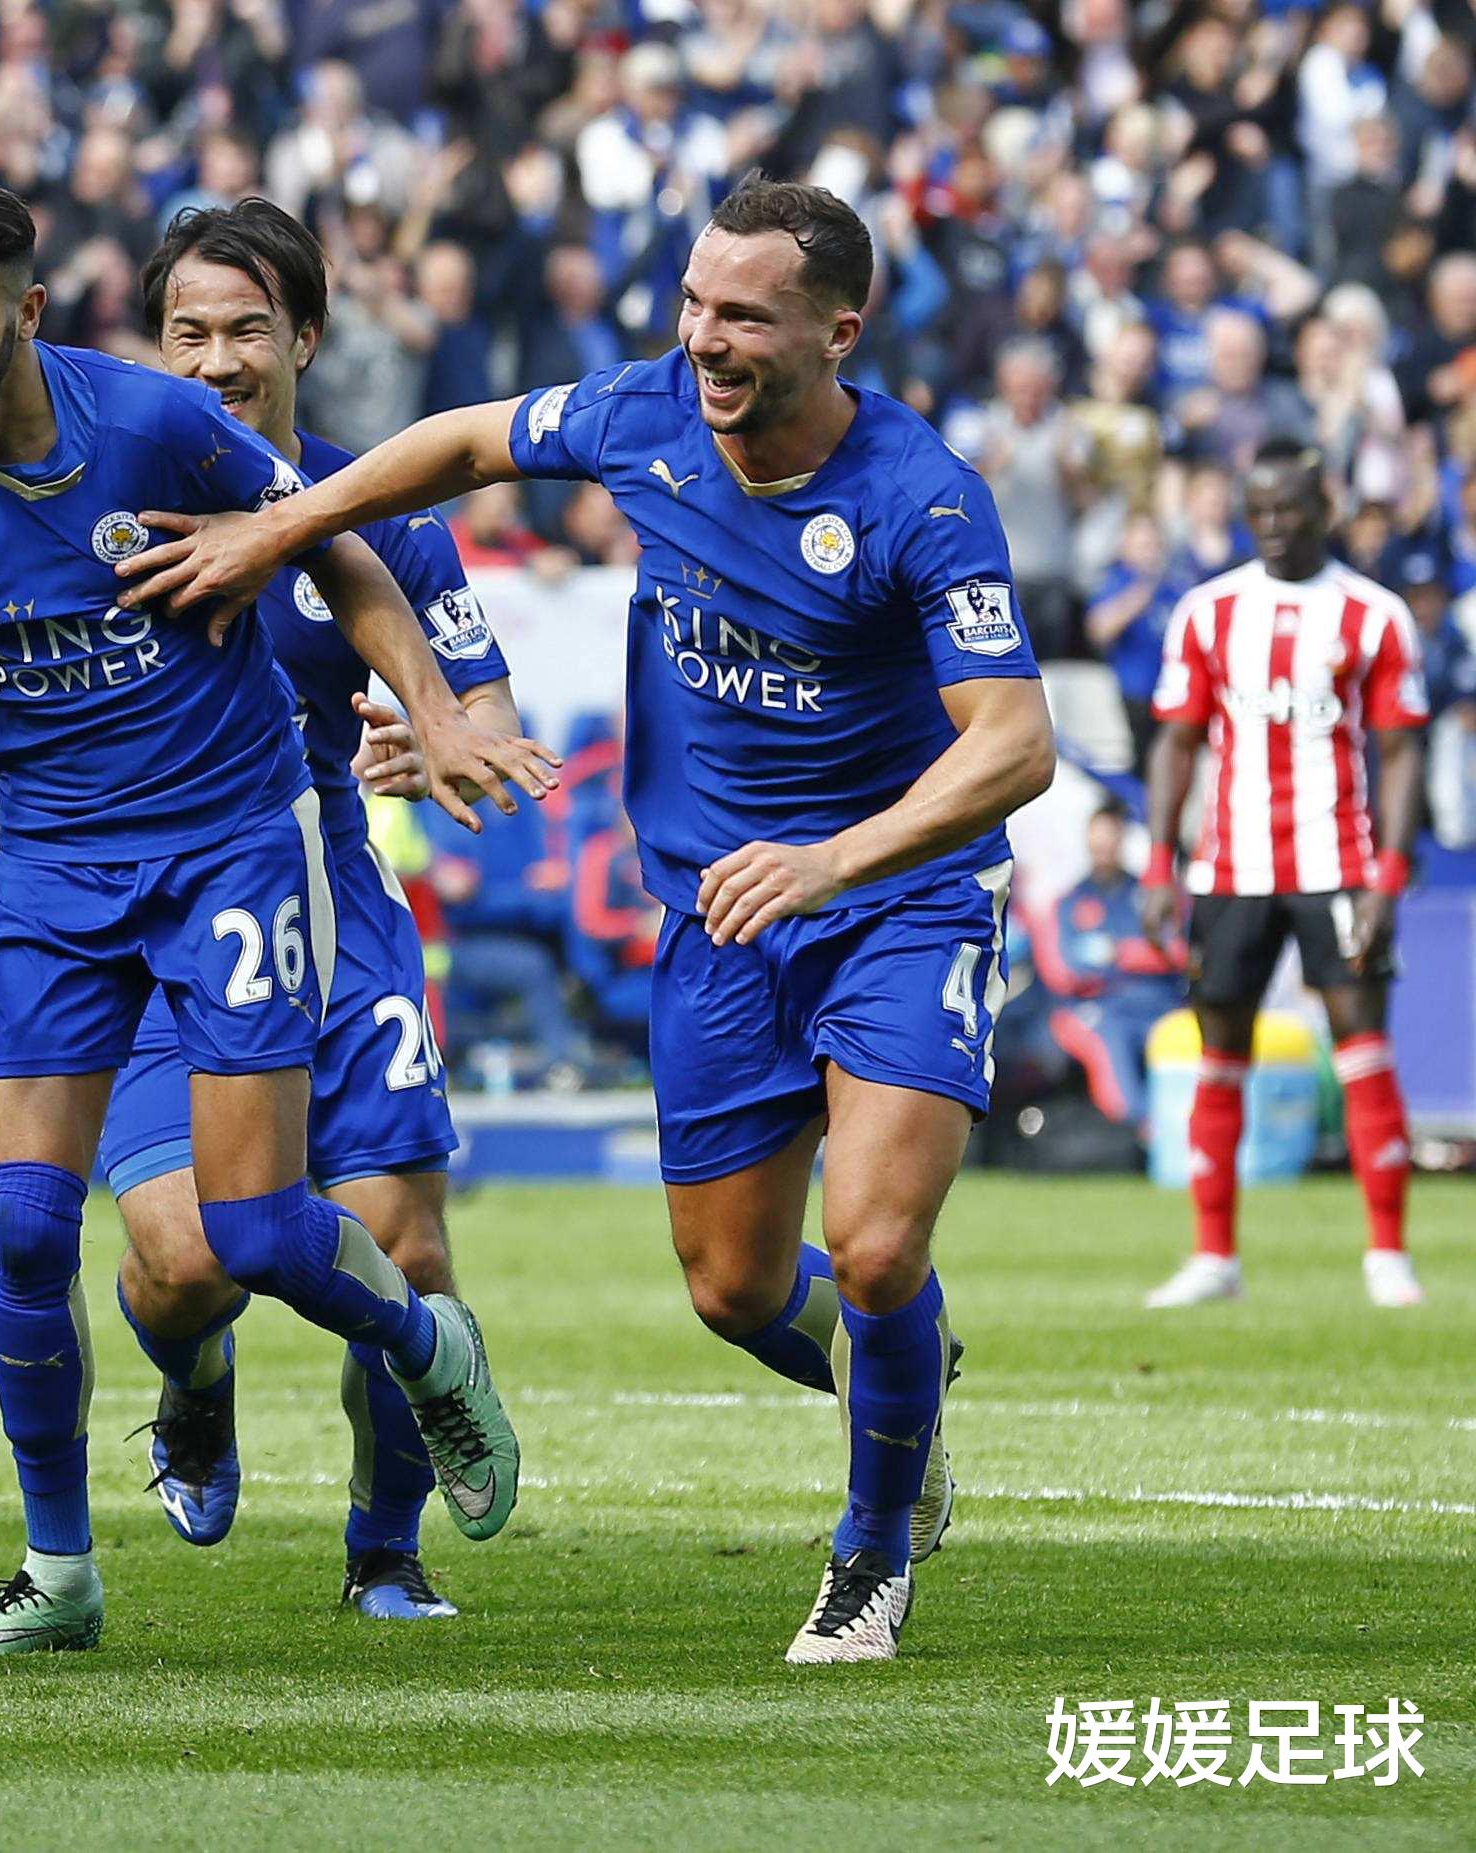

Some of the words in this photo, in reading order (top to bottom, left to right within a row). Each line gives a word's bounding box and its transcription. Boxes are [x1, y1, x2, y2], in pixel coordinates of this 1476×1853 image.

[662, 632, 823, 712] POWER
[964, 625, 1009, 638] BARCLAYS
[212, 895, 305, 1008] 26
[942, 942, 982, 1040] 4
